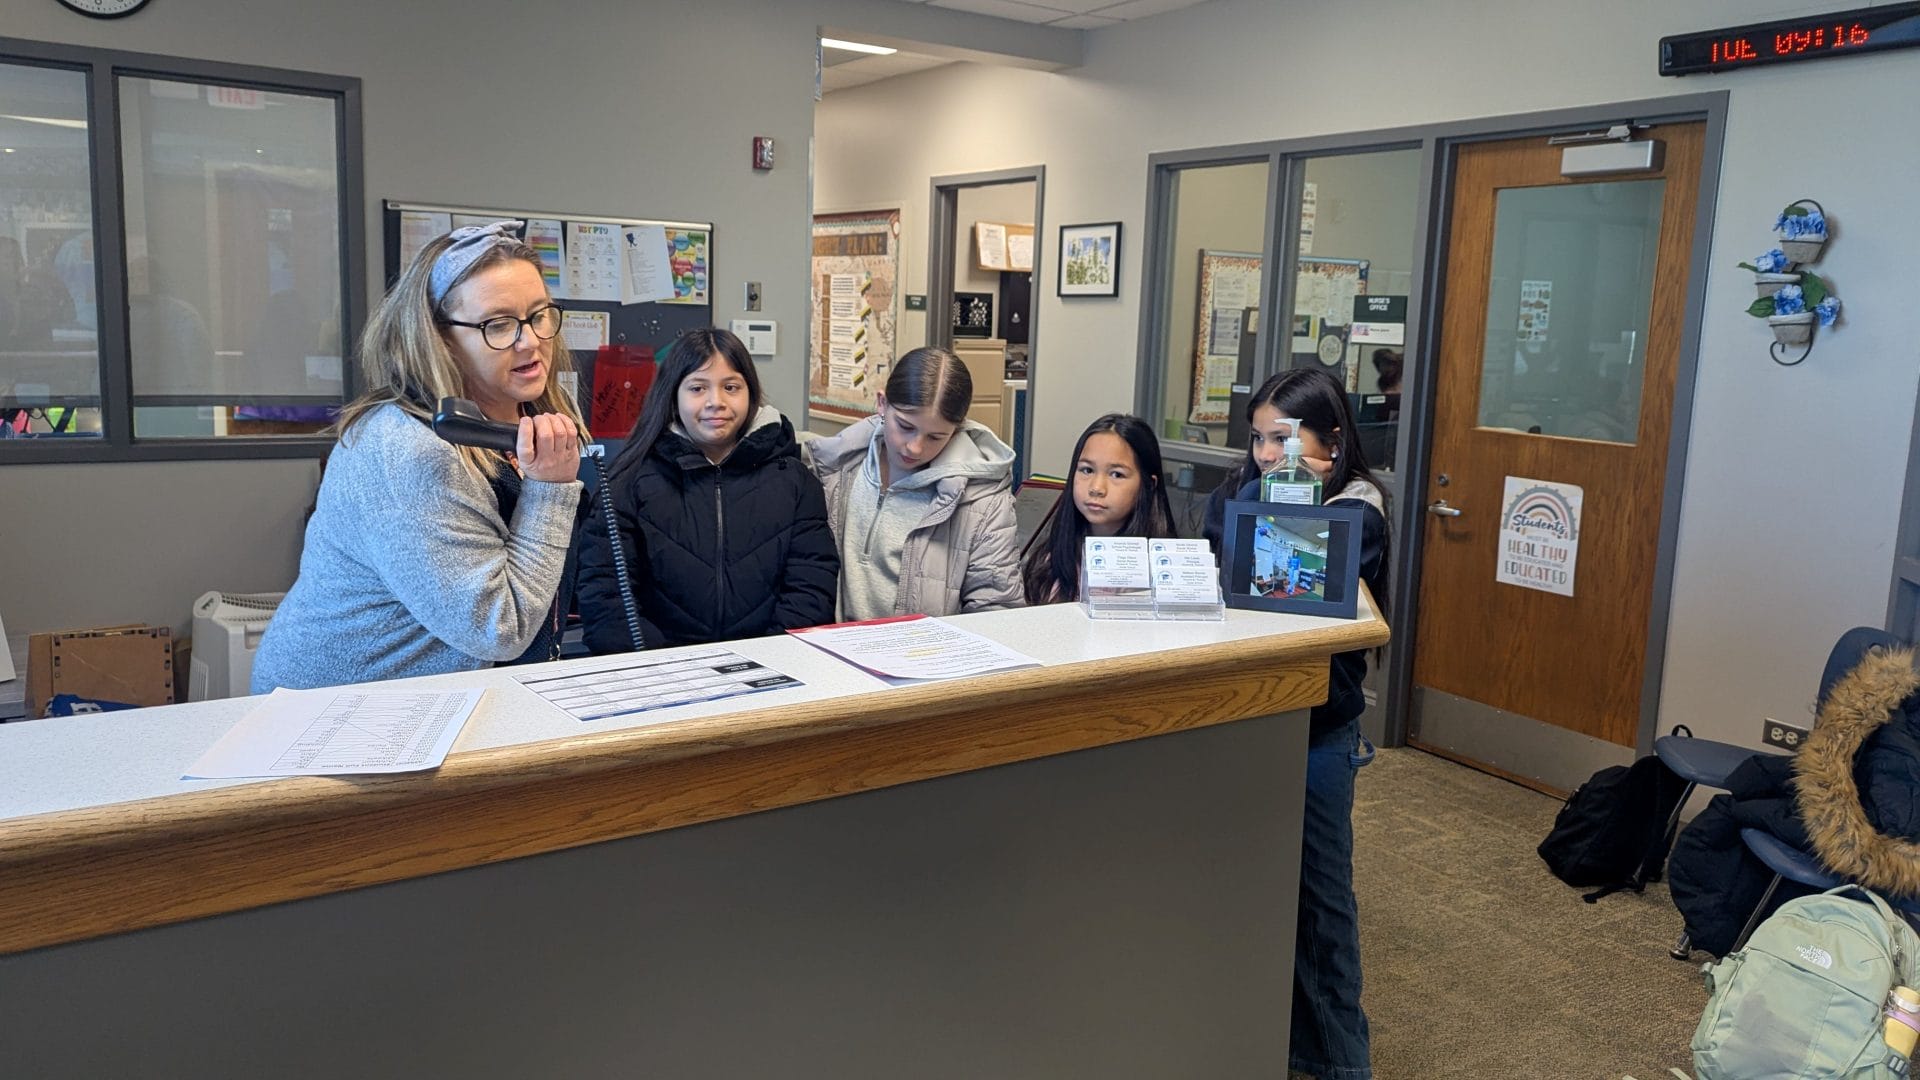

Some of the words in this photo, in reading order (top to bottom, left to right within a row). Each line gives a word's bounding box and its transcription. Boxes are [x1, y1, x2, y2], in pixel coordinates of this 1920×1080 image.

[1512, 514, 1566, 535] Students
[1508, 539, 1568, 563] HEALTHY
[1504, 560, 1568, 585] EDUCATED
